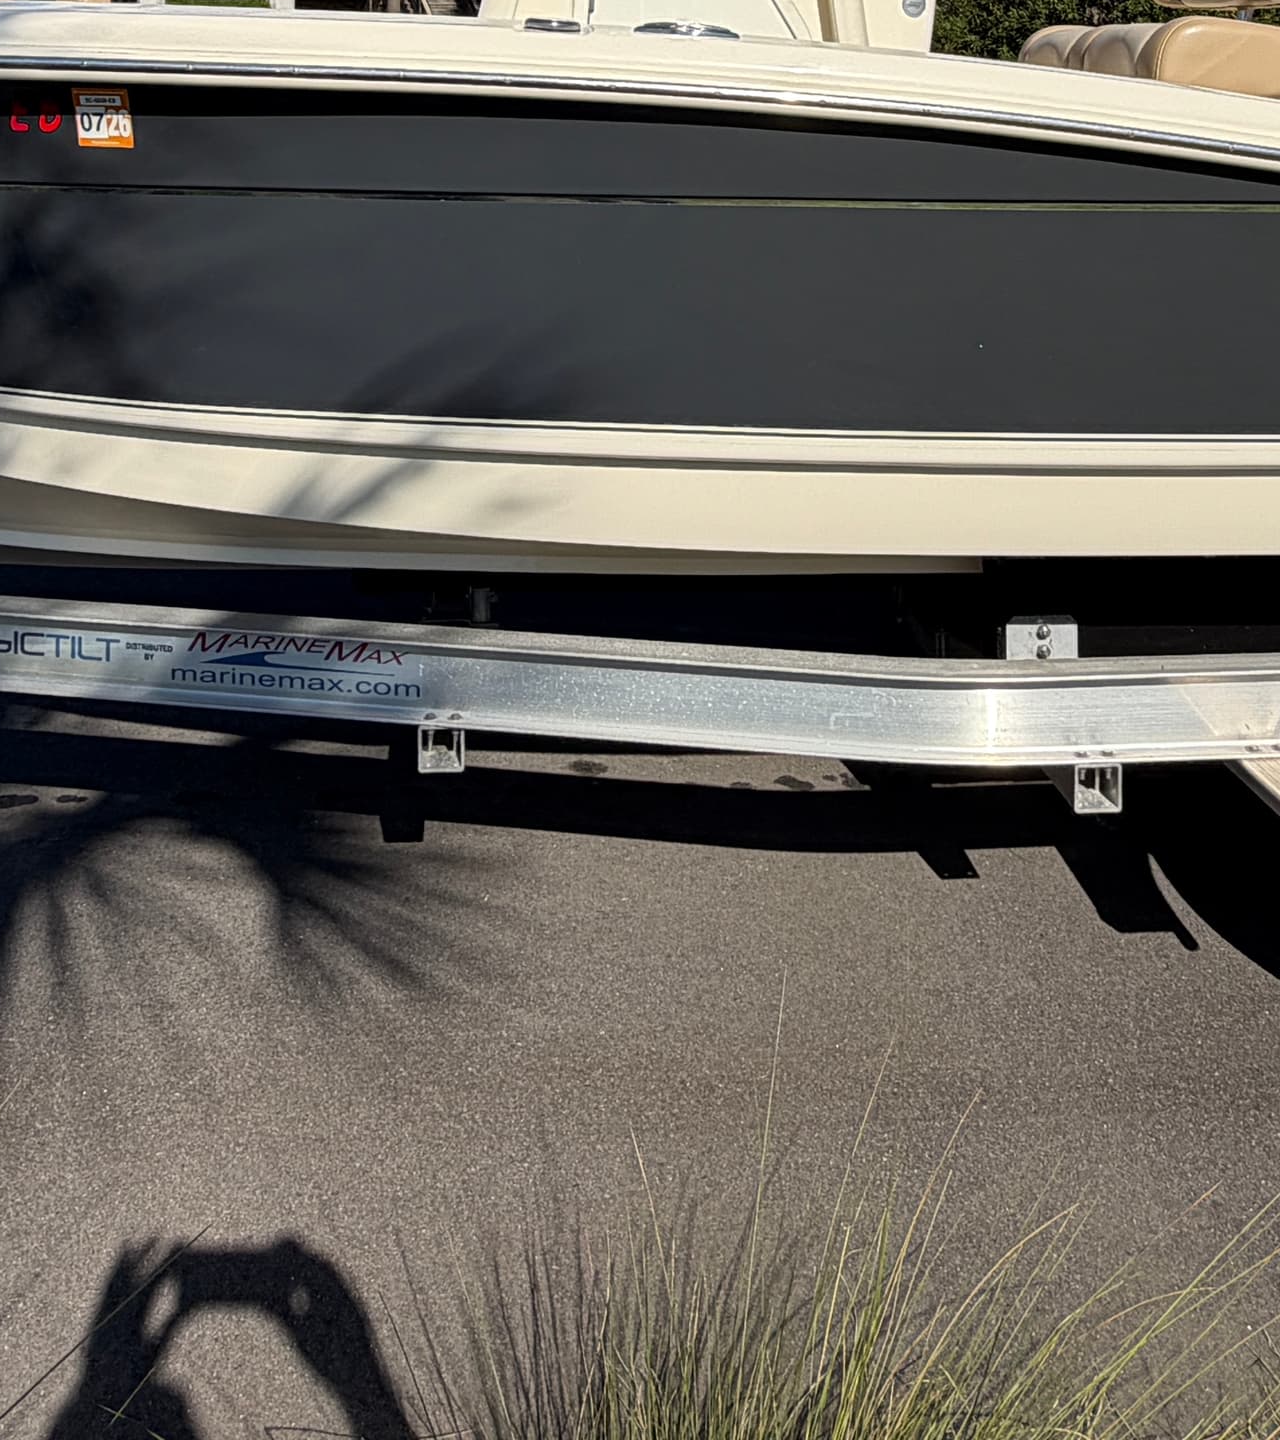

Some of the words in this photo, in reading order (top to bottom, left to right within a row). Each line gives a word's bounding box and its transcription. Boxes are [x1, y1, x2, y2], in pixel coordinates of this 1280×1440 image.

[80, 111, 105, 133] 07
[106, 109, 132, 138] 26
[125, 641, 174, 653] DISTRIBUTED
[143, 653, 155, 661] BY
[170, 666, 421, 698] marinemax.com
